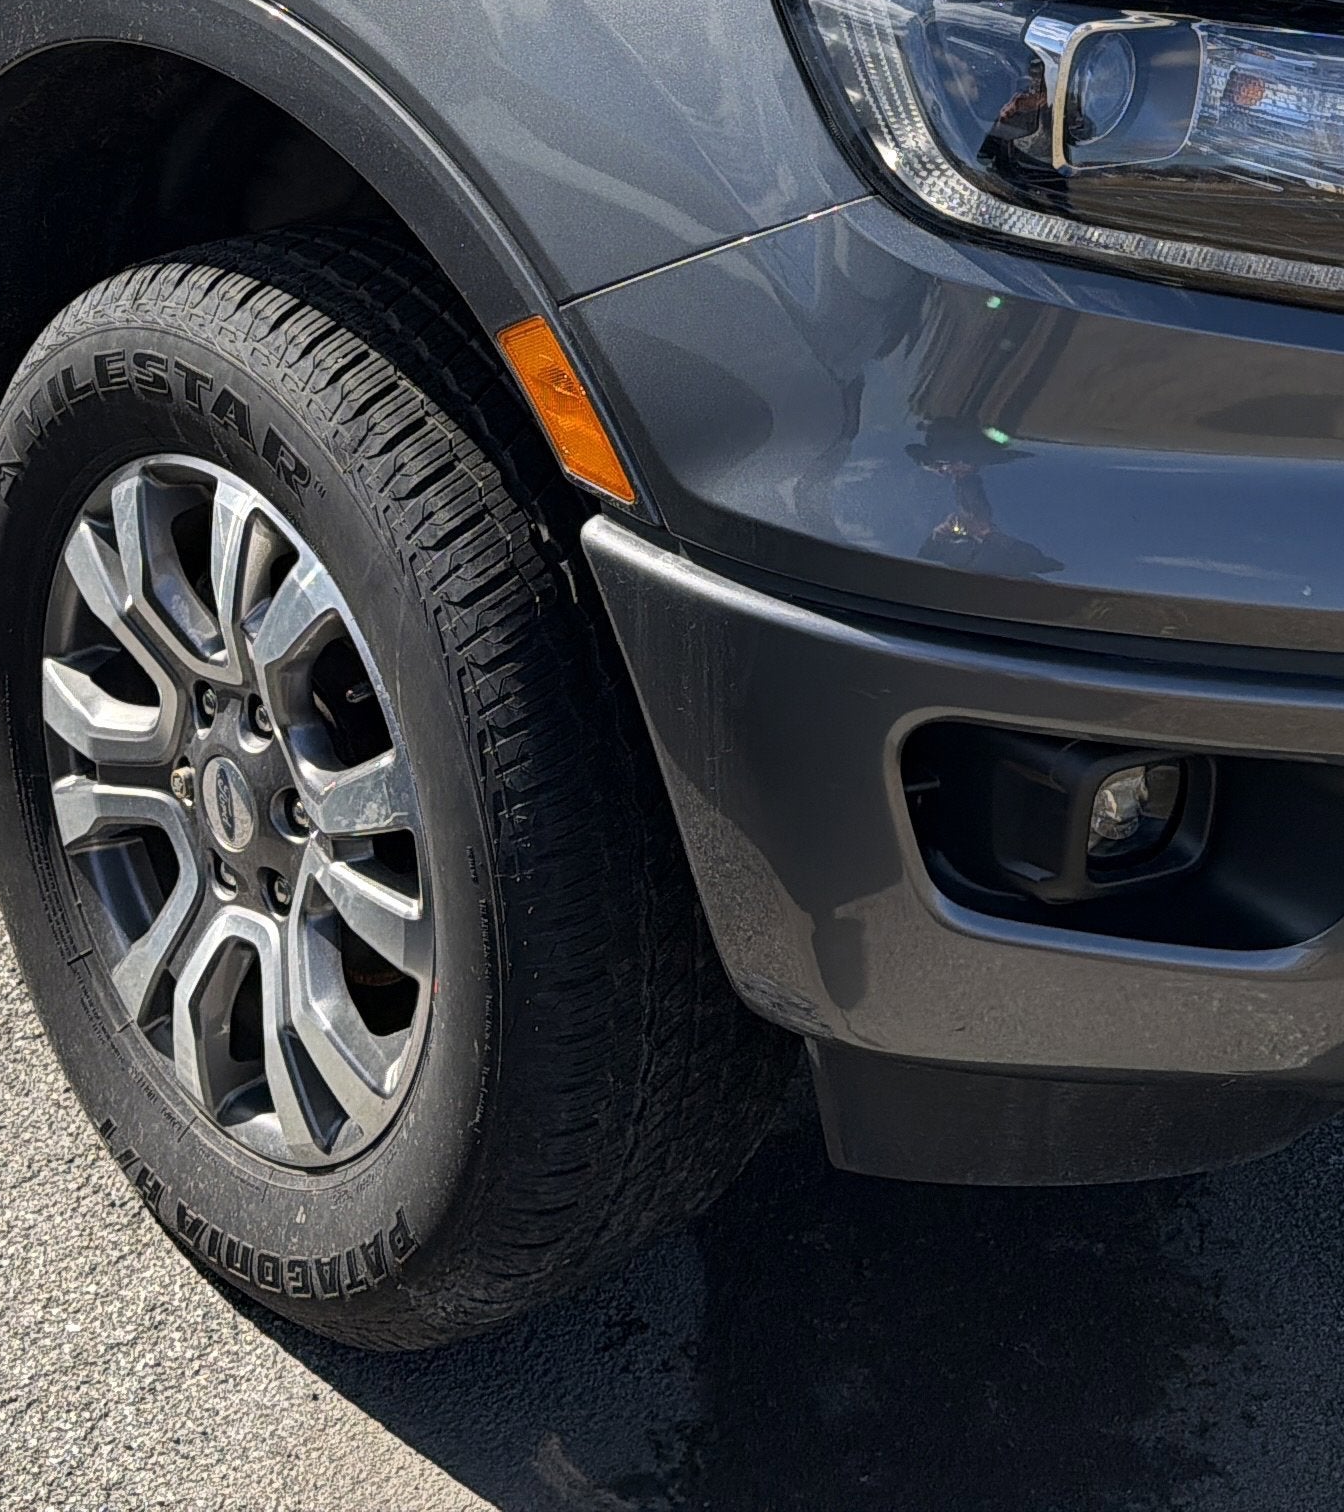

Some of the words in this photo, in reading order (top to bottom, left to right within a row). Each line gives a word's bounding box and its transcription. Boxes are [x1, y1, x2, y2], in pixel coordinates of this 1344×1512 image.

[13, 348, 312, 500] MILESTAR
[217, 778, 233, 829] Ford
[175, 1198, 420, 1299] PATAGONIA
